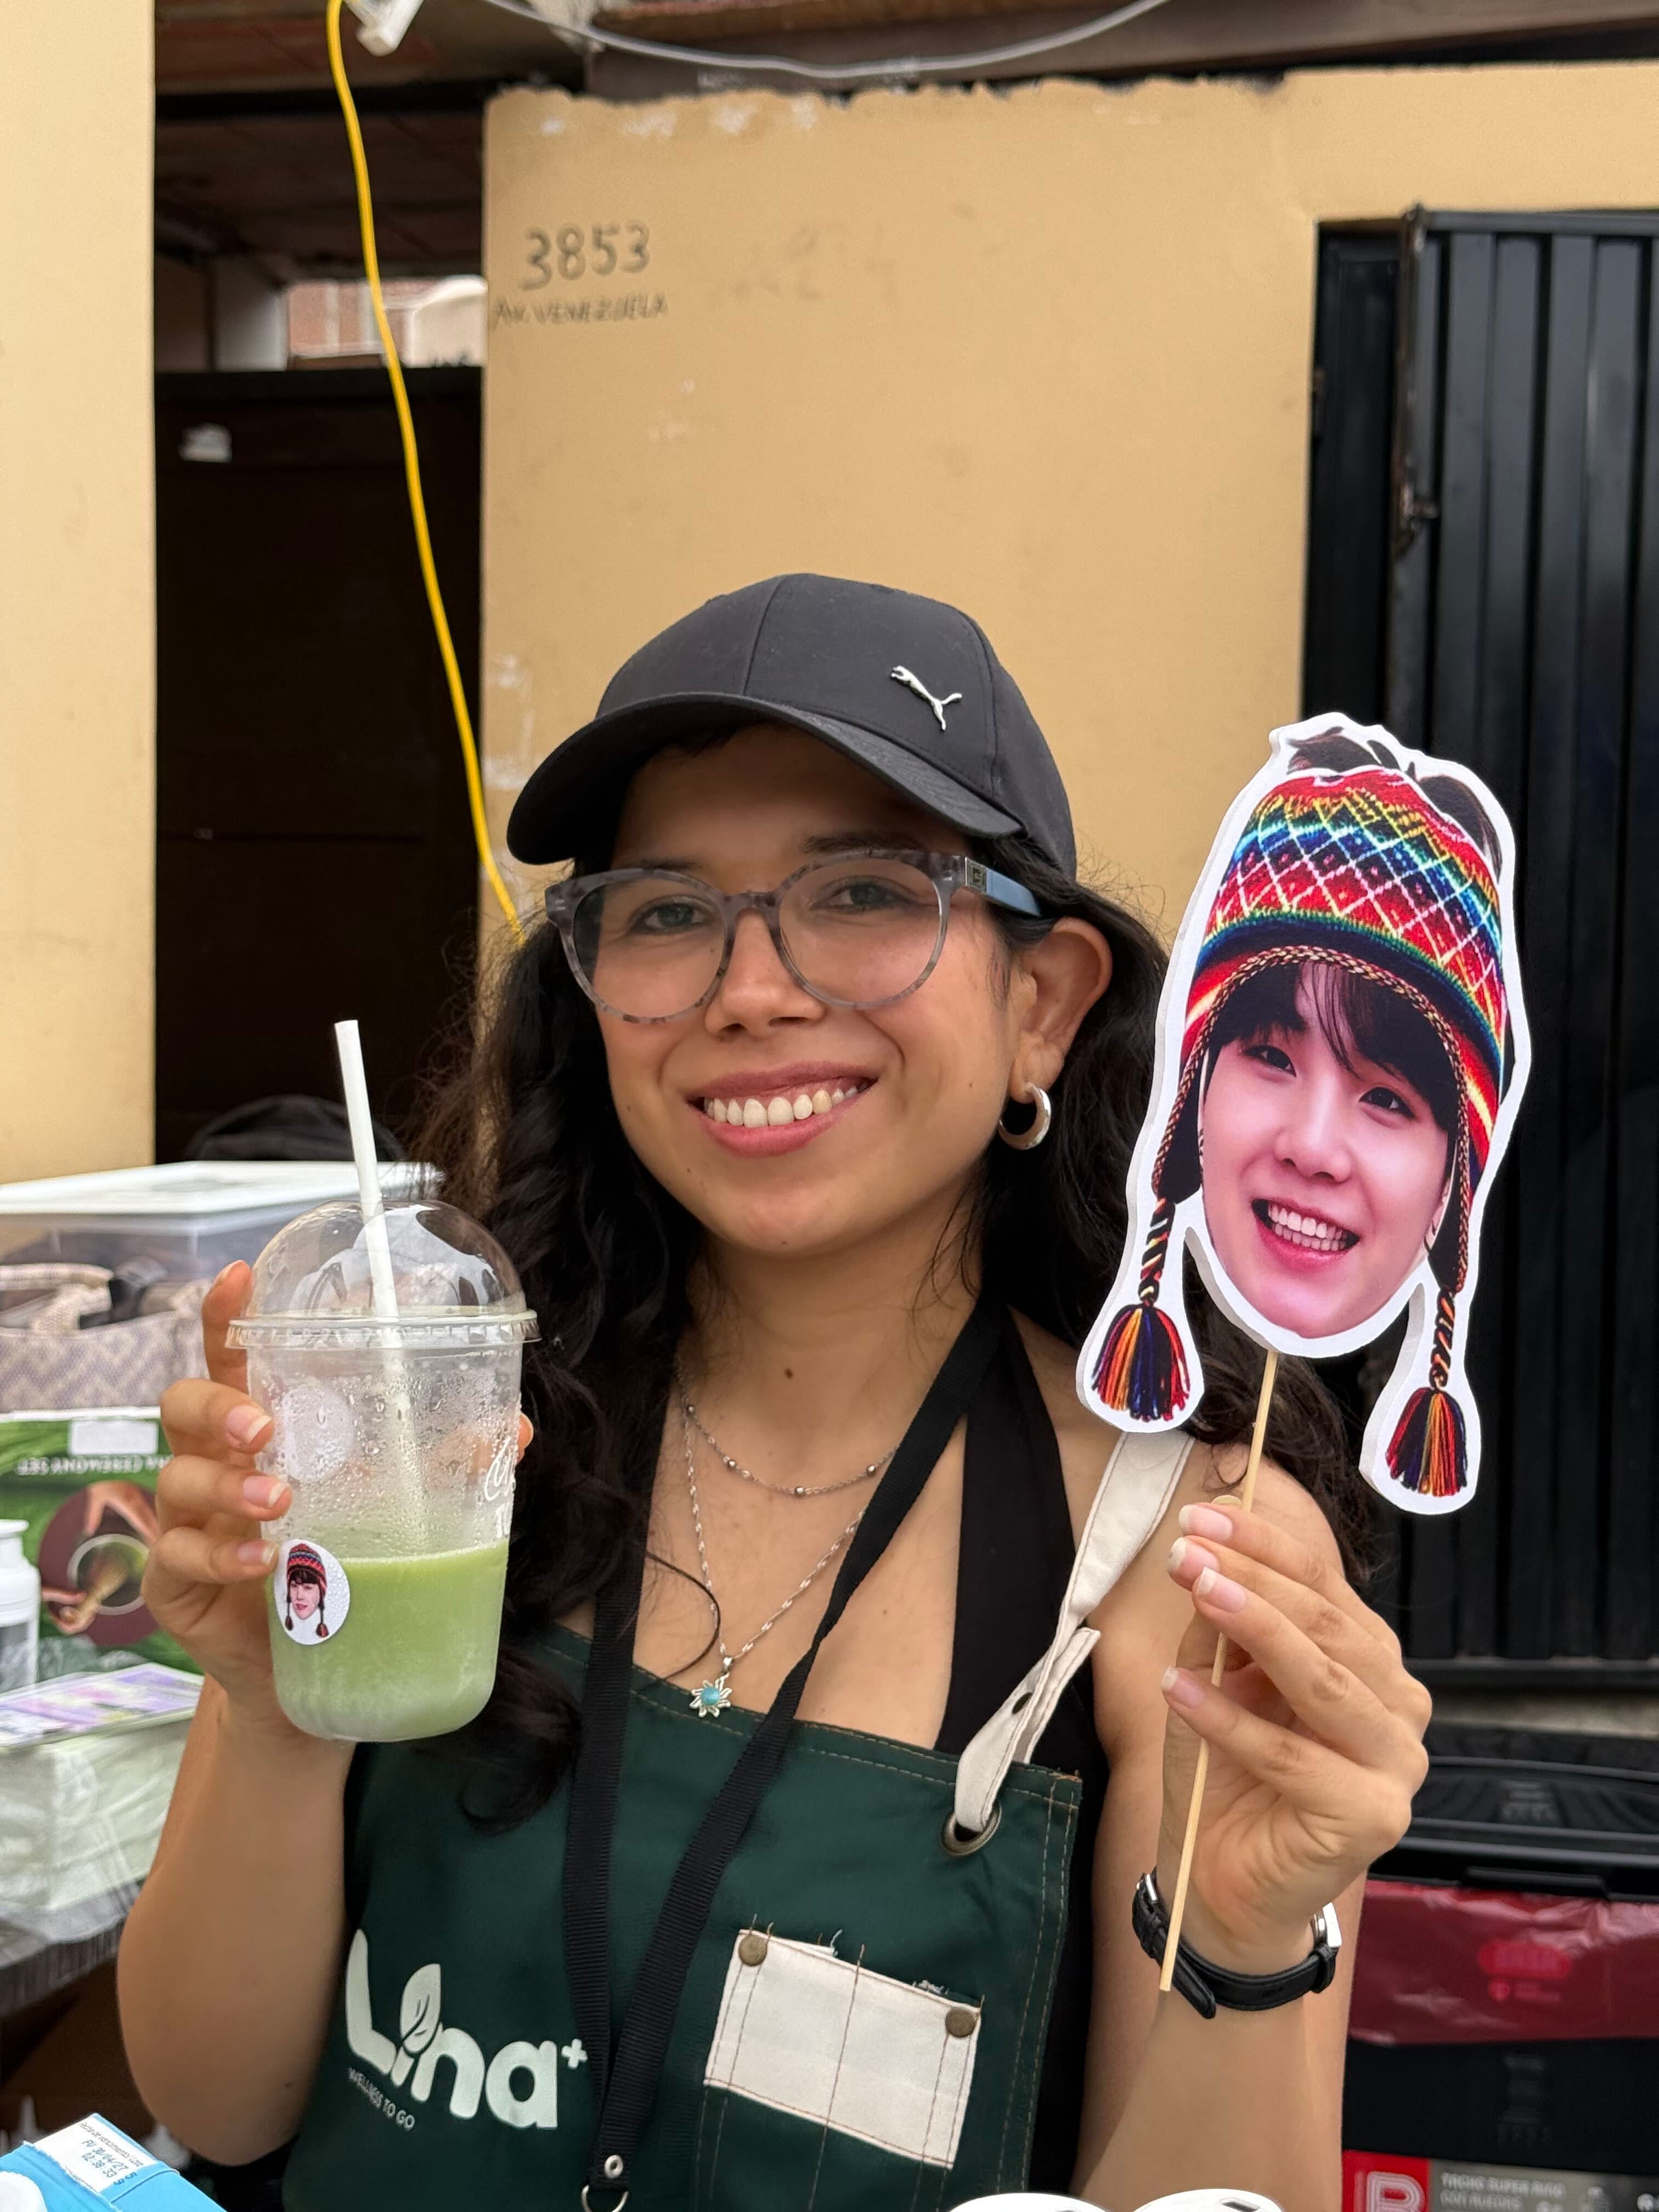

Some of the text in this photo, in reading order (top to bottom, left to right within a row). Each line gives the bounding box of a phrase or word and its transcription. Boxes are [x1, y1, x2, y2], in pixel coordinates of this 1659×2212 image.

[518, 221, 651, 290] 3853
[532, 292, 668, 324] VENEZUELA
[382, 2097, 396, 2119] TO
[396, 2109, 415, 2131] GO
